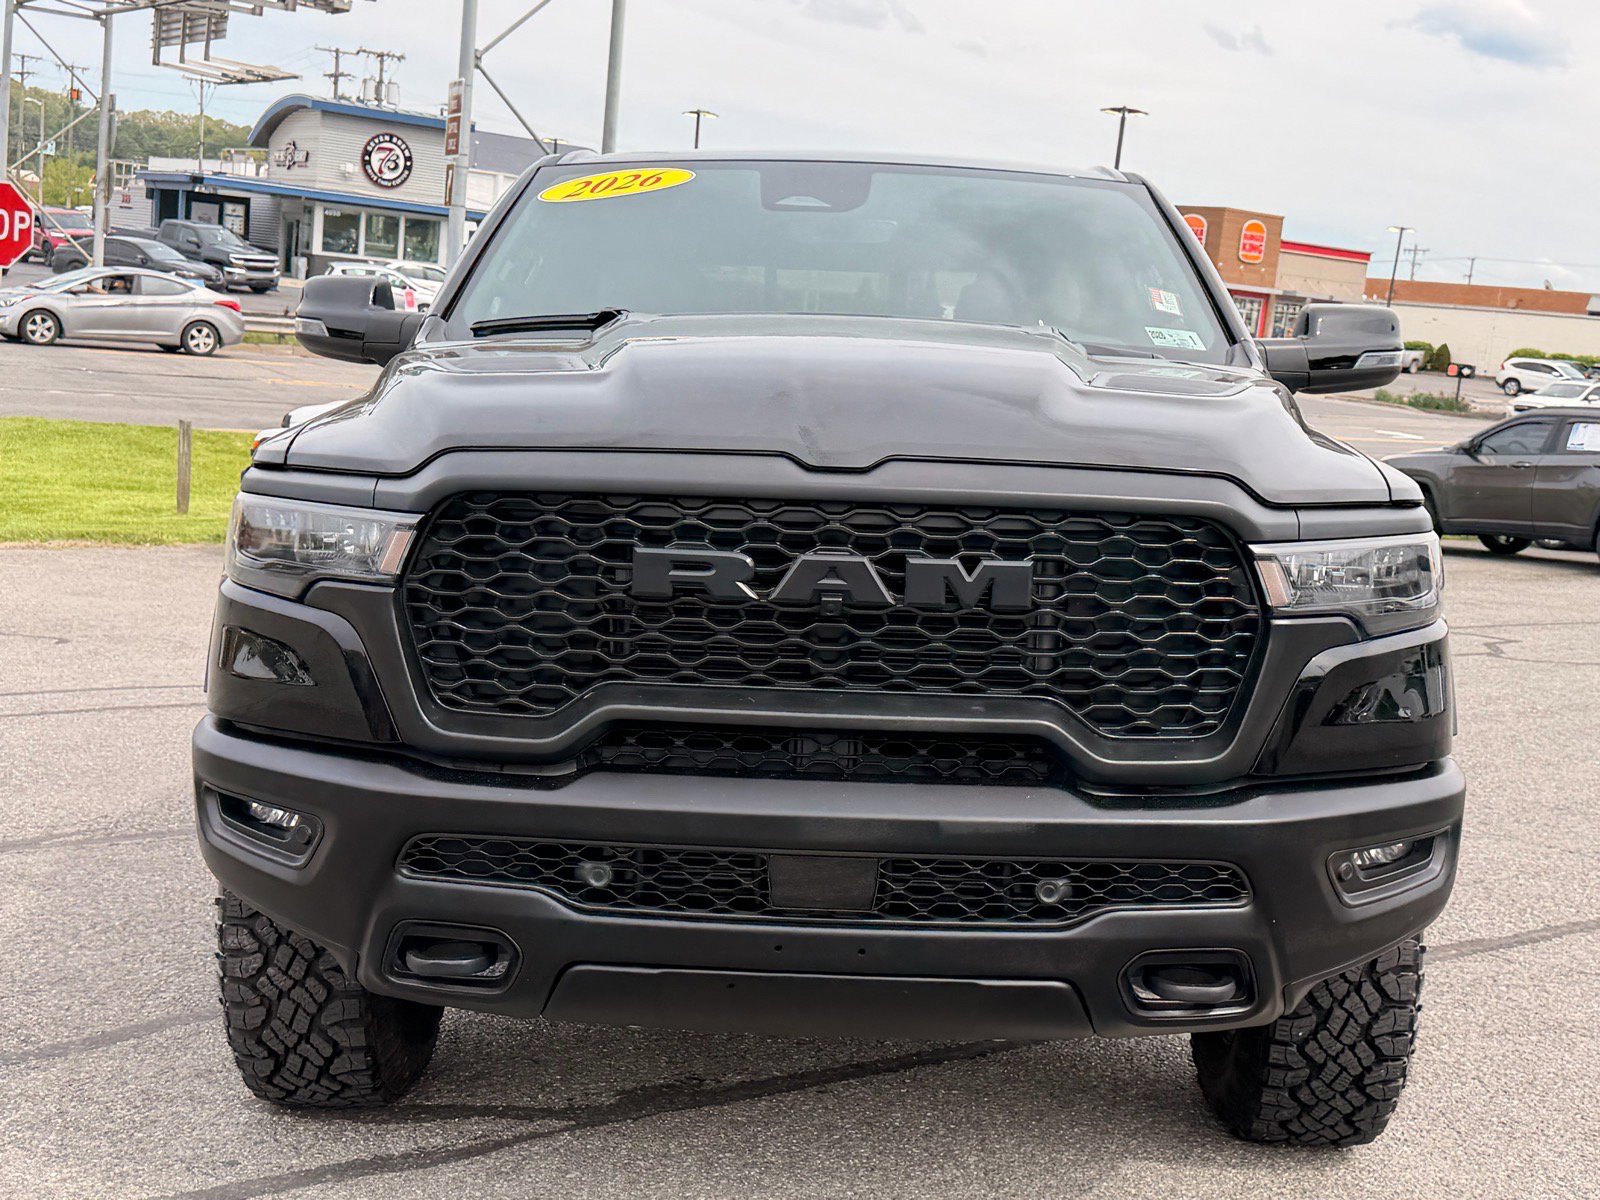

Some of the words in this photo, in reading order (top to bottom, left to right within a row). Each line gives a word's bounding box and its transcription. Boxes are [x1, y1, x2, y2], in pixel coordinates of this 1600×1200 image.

[366, 134, 390, 151] SEVEN
[562, 170, 665, 199] 2026
[632, 546, 1034, 609] RAM
